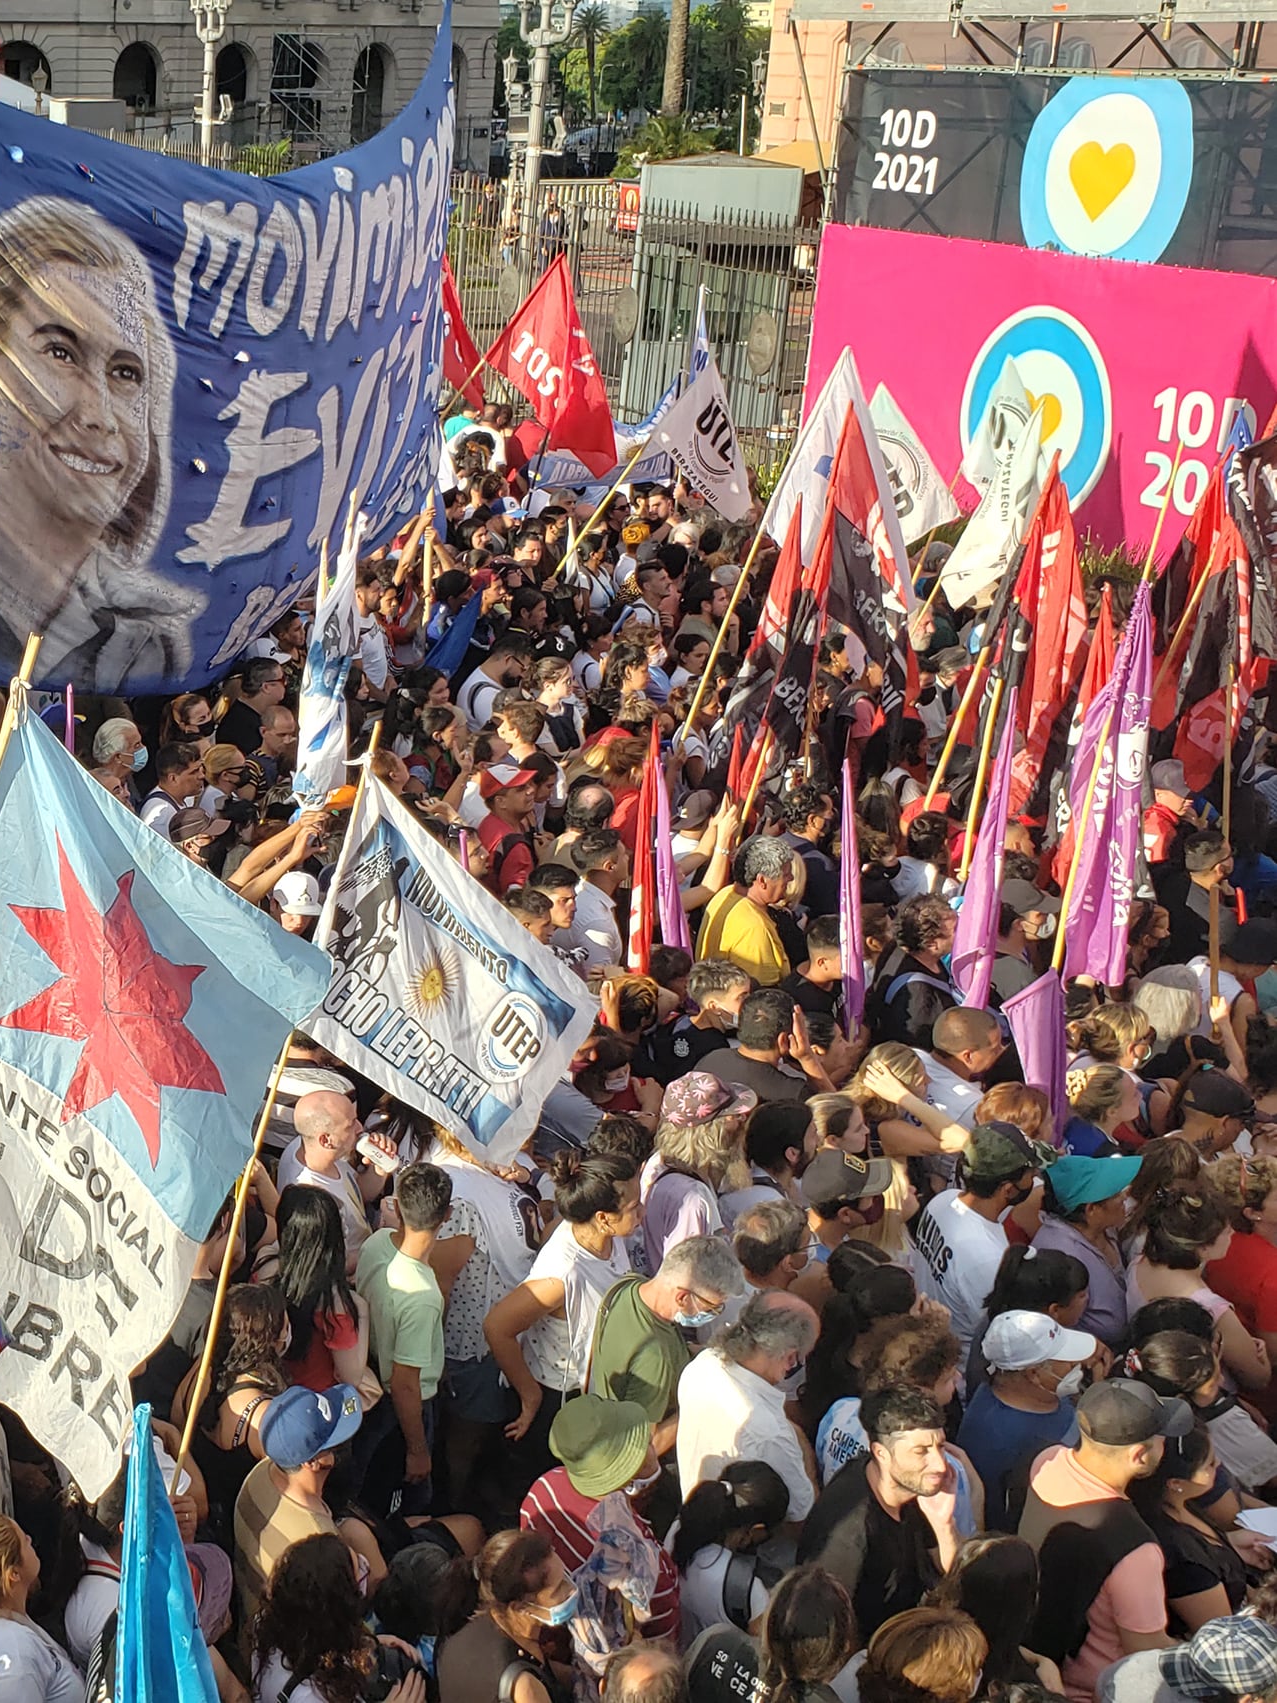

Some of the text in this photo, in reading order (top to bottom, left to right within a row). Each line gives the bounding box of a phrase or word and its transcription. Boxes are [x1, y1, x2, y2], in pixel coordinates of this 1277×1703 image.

[878, 107, 938, 149] 10D
[872, 154, 939, 195] 2021
[1139, 451, 1210, 516] 20
[405, 867, 509, 985] MOVIMIENTO
[323, 959, 492, 1121] OCHO LEPRATTI
[490, 1003, 541, 1065] UTEP
[63, 1145, 167, 1288] SOCIAL
